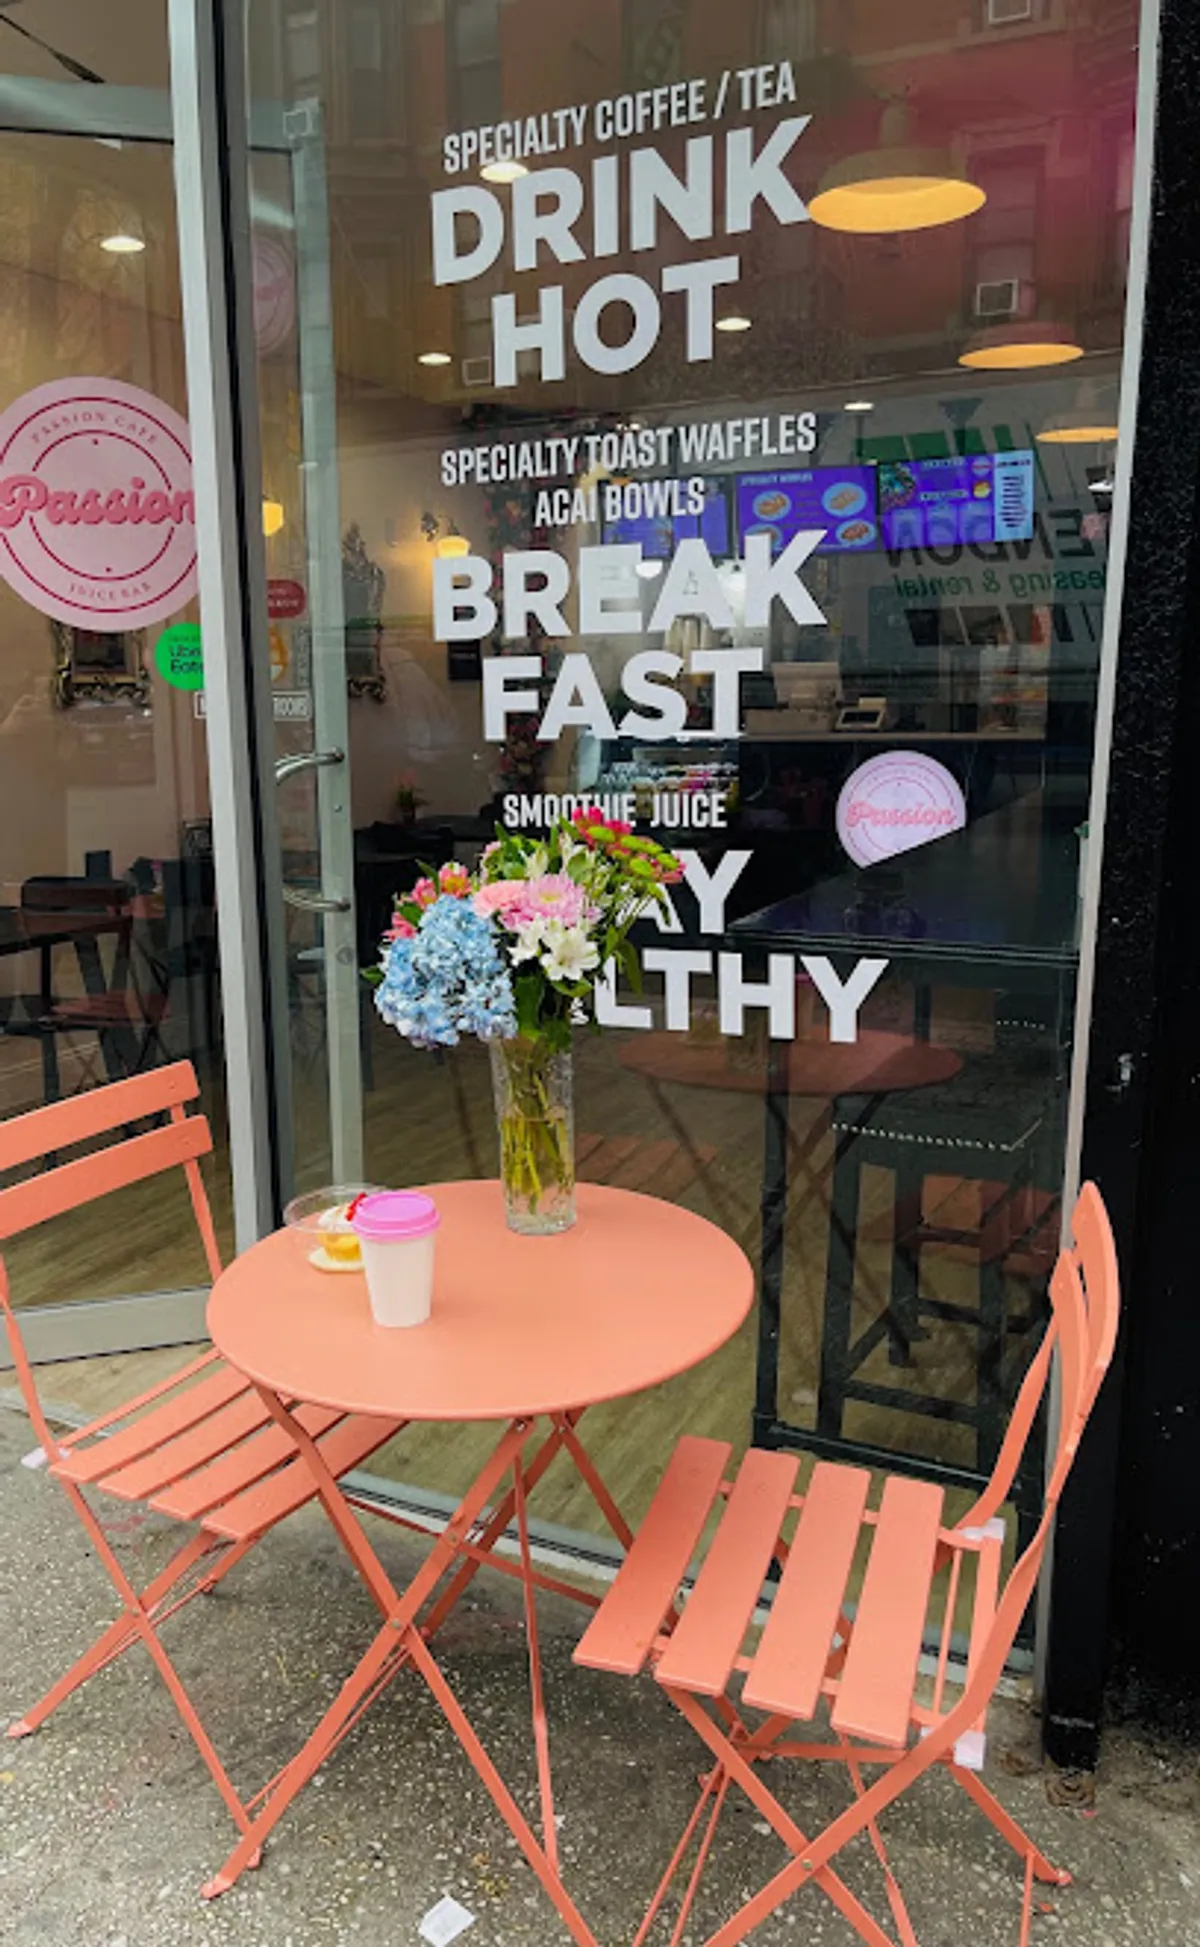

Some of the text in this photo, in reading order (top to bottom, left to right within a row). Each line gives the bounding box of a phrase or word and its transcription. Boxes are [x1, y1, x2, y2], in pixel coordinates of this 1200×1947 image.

[443, 104, 589, 174] SPECIALTY
[595, 79, 706, 142] COFFEE
[737, 61, 797, 111] TEA
[431, 114, 813, 287] DRINK
[491, 255, 740, 388] HOT
[441, 412, 818, 487] SPECIALTY TOAST WAFFLES
[0, 474, 195, 529] Passion
[535, 477, 705, 528] ACAI BOWLS
[432, 529, 828, 642] BREAK
[482, 647, 764, 742] FAST
[503, 793, 728, 828] SMOOTHIE JUICE
[571, 948, 889, 1043] LTHY
